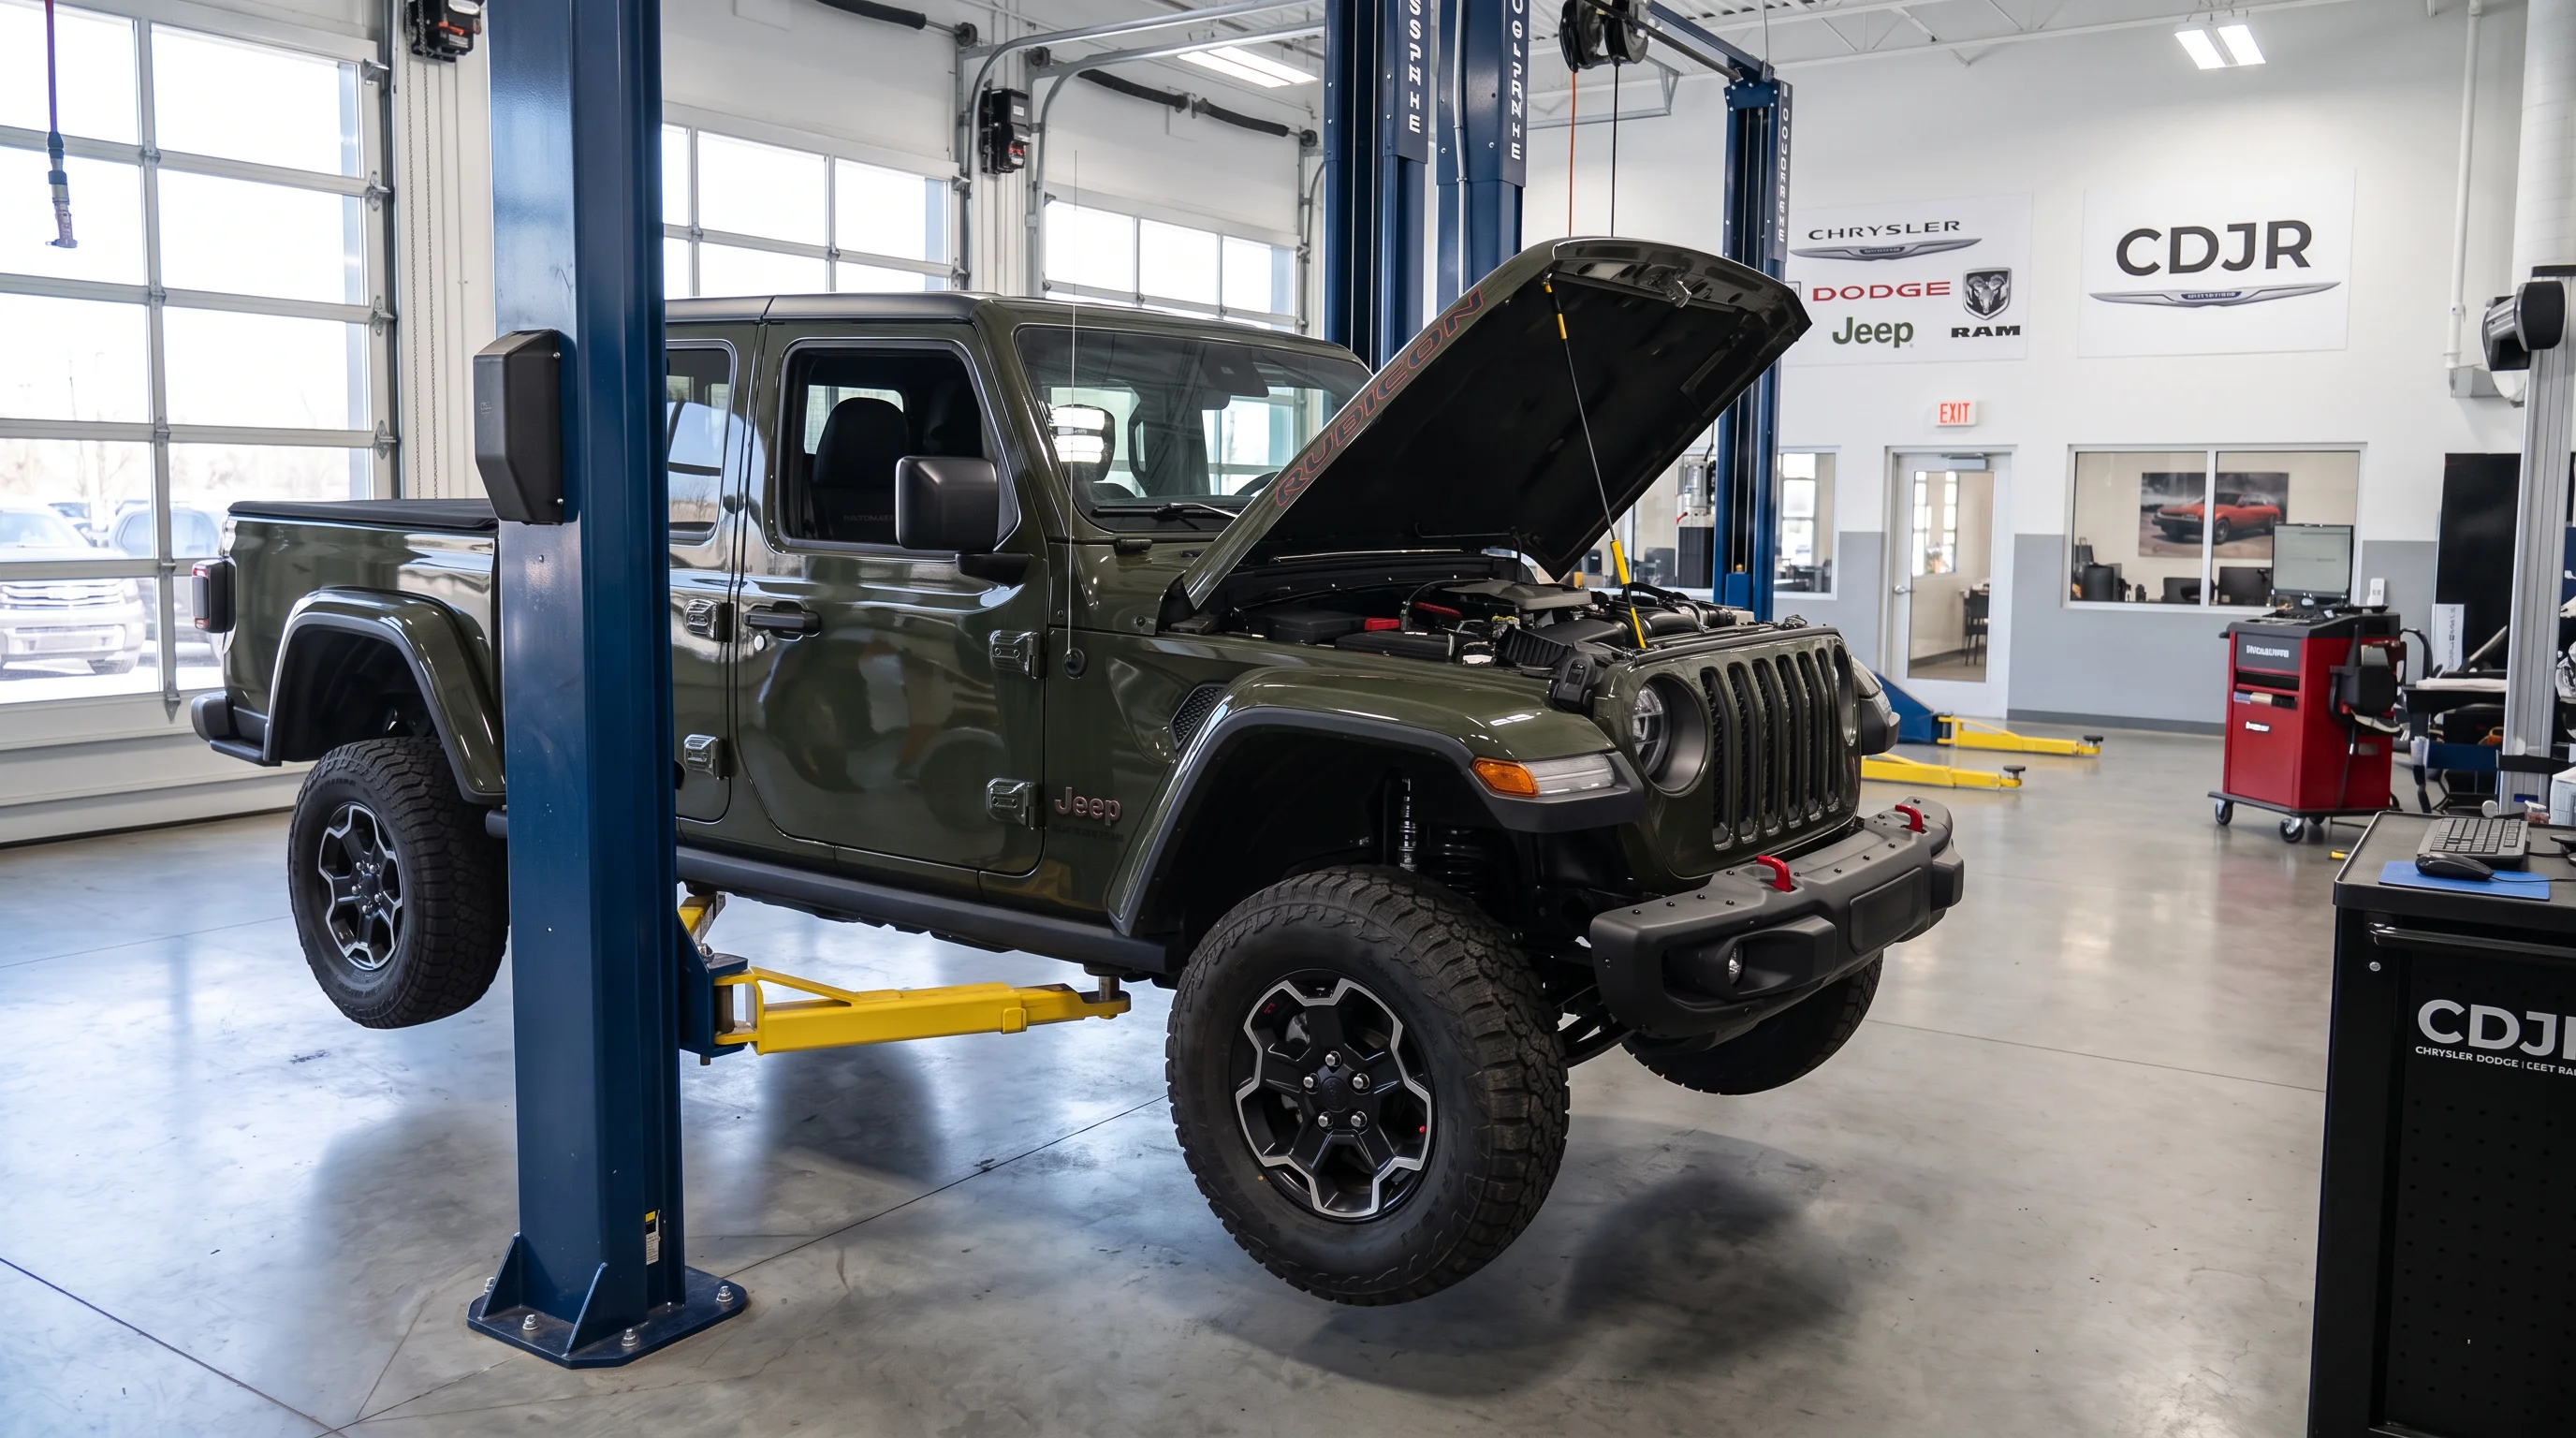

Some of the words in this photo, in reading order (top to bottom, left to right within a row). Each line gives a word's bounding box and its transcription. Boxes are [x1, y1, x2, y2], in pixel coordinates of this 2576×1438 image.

[1808, 220, 1961, 241] CHRYSLER
[2115, 220, 2312, 277] CDJR
[1812, 282, 1951, 301] DODGE
[1832, 316, 1914, 348] Jeep
[1951, 325, 2021, 338] RAM
[1276, 287, 1485, 506] RUBICON
[1939, 403, 1970, 423] EXIT
[1055, 786, 1121, 826] Jeep
[2415, 1046, 2473, 1062] CHRYSLER
[2476, 1054, 2519, 1068] DODGE
[2558, 1066, 2576, 1077] RA
